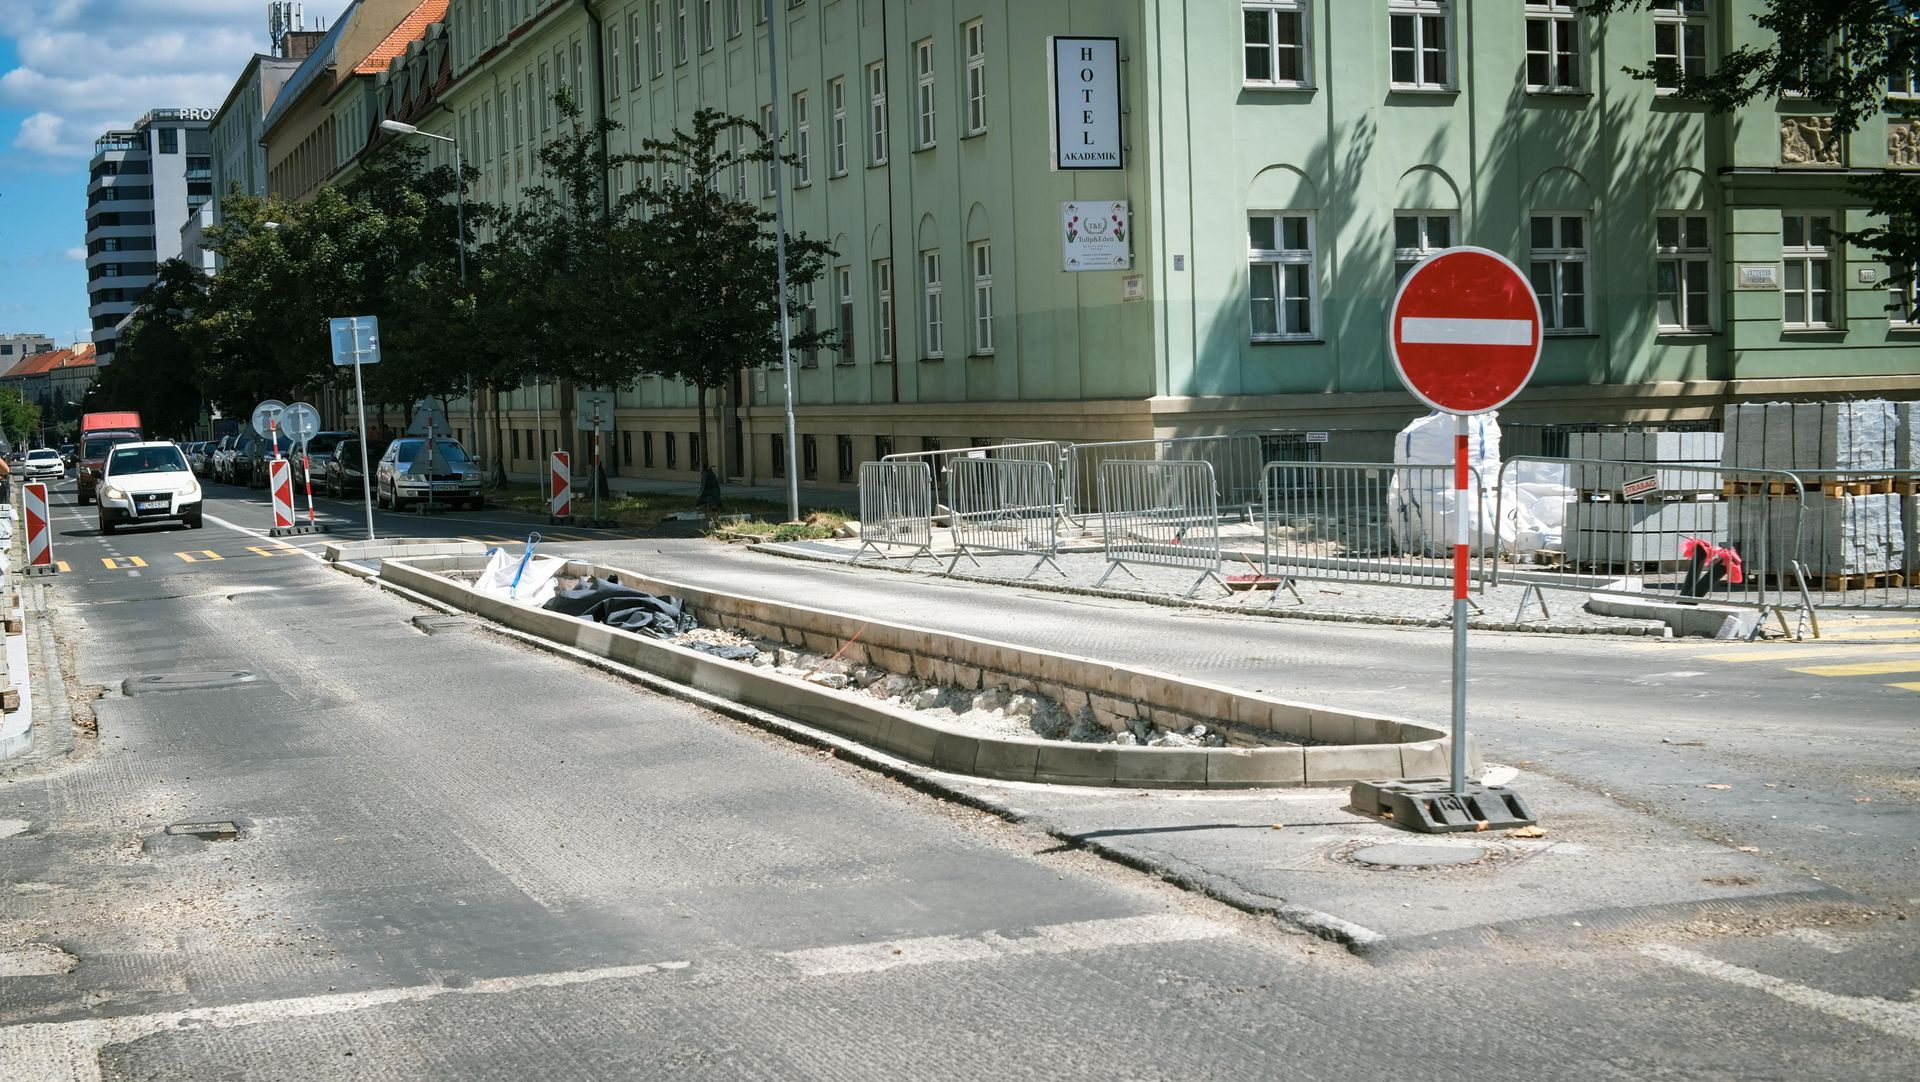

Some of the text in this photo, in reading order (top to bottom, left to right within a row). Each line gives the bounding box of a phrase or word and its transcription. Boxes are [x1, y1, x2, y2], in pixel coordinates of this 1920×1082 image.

[1080, 47, 1095, 146] HOTEL
[180, 108, 217, 120] PRO
[1064, 152, 1117, 161] AKADEMIK
[1078, 235, 1115, 244] Tulip&Eden
[1625, 480, 1656, 493] STRABAG
